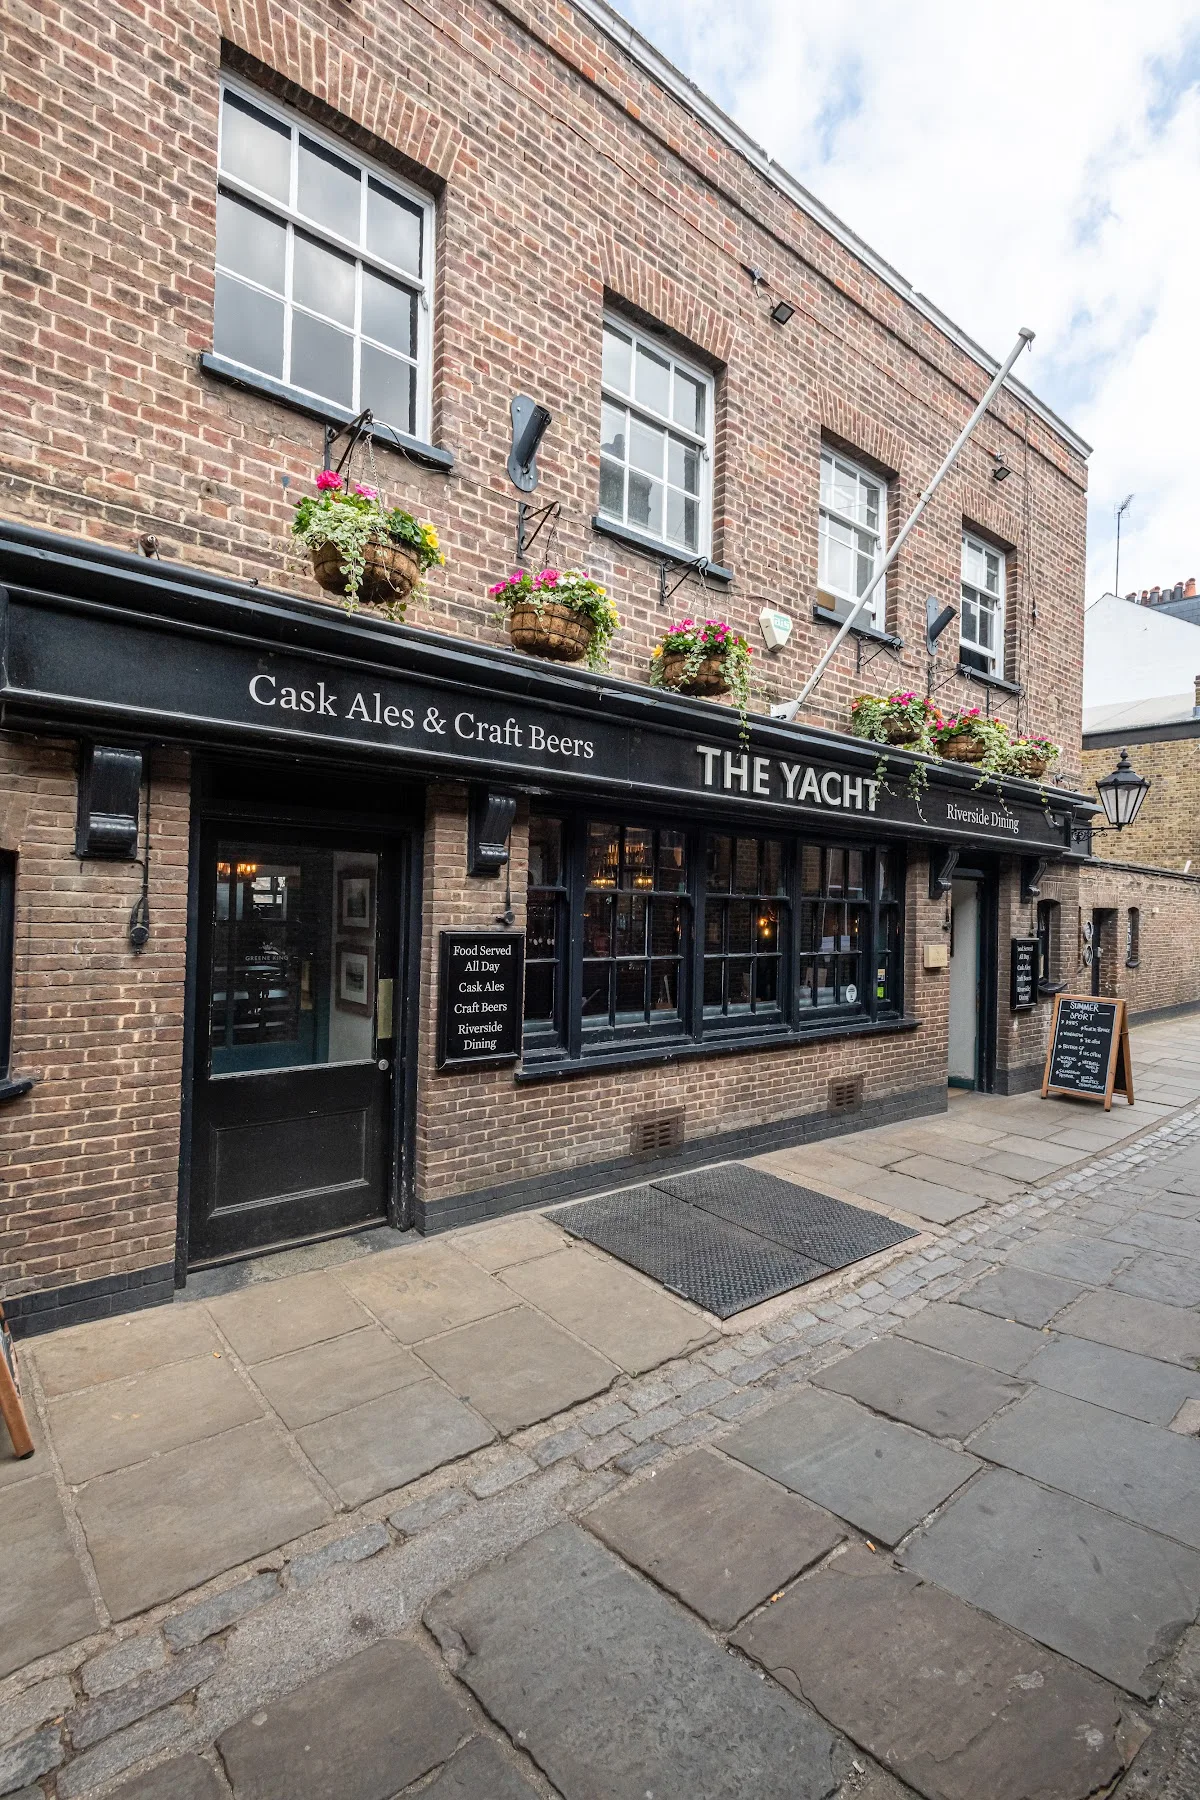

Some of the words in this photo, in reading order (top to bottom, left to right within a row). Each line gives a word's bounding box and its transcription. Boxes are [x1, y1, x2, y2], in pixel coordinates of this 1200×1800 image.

[249, 675, 338, 717] Cask
[345, 693, 415, 729] Ales
[422, 707, 446, 735] &
[454, 712, 523, 747] Craft
[528, 724, 594, 759] Beers
[697, 745, 771, 795] THE
[779, 761, 880, 812] YACHT
[946, 803, 990, 827] Riverside
[991, 811, 1019, 834] Dining
[453, 945, 478, 956] Food
[480, 945, 512, 956] Served
[464, 960, 480, 972] All
[481, 961, 500, 973] Day
[458, 981, 482, 993] Cask
[484, 980, 505, 992] Ales
[454, 1002, 480, 1014] Craft
[481, 1002, 507, 1013] Beers
[1070, 1001, 1099, 1012] SUMMER
[1070, 1013, 1094, 1021] SPORT
[458, 1021, 503, 1035] Riverside
[463, 1038, 497, 1050] Dining
